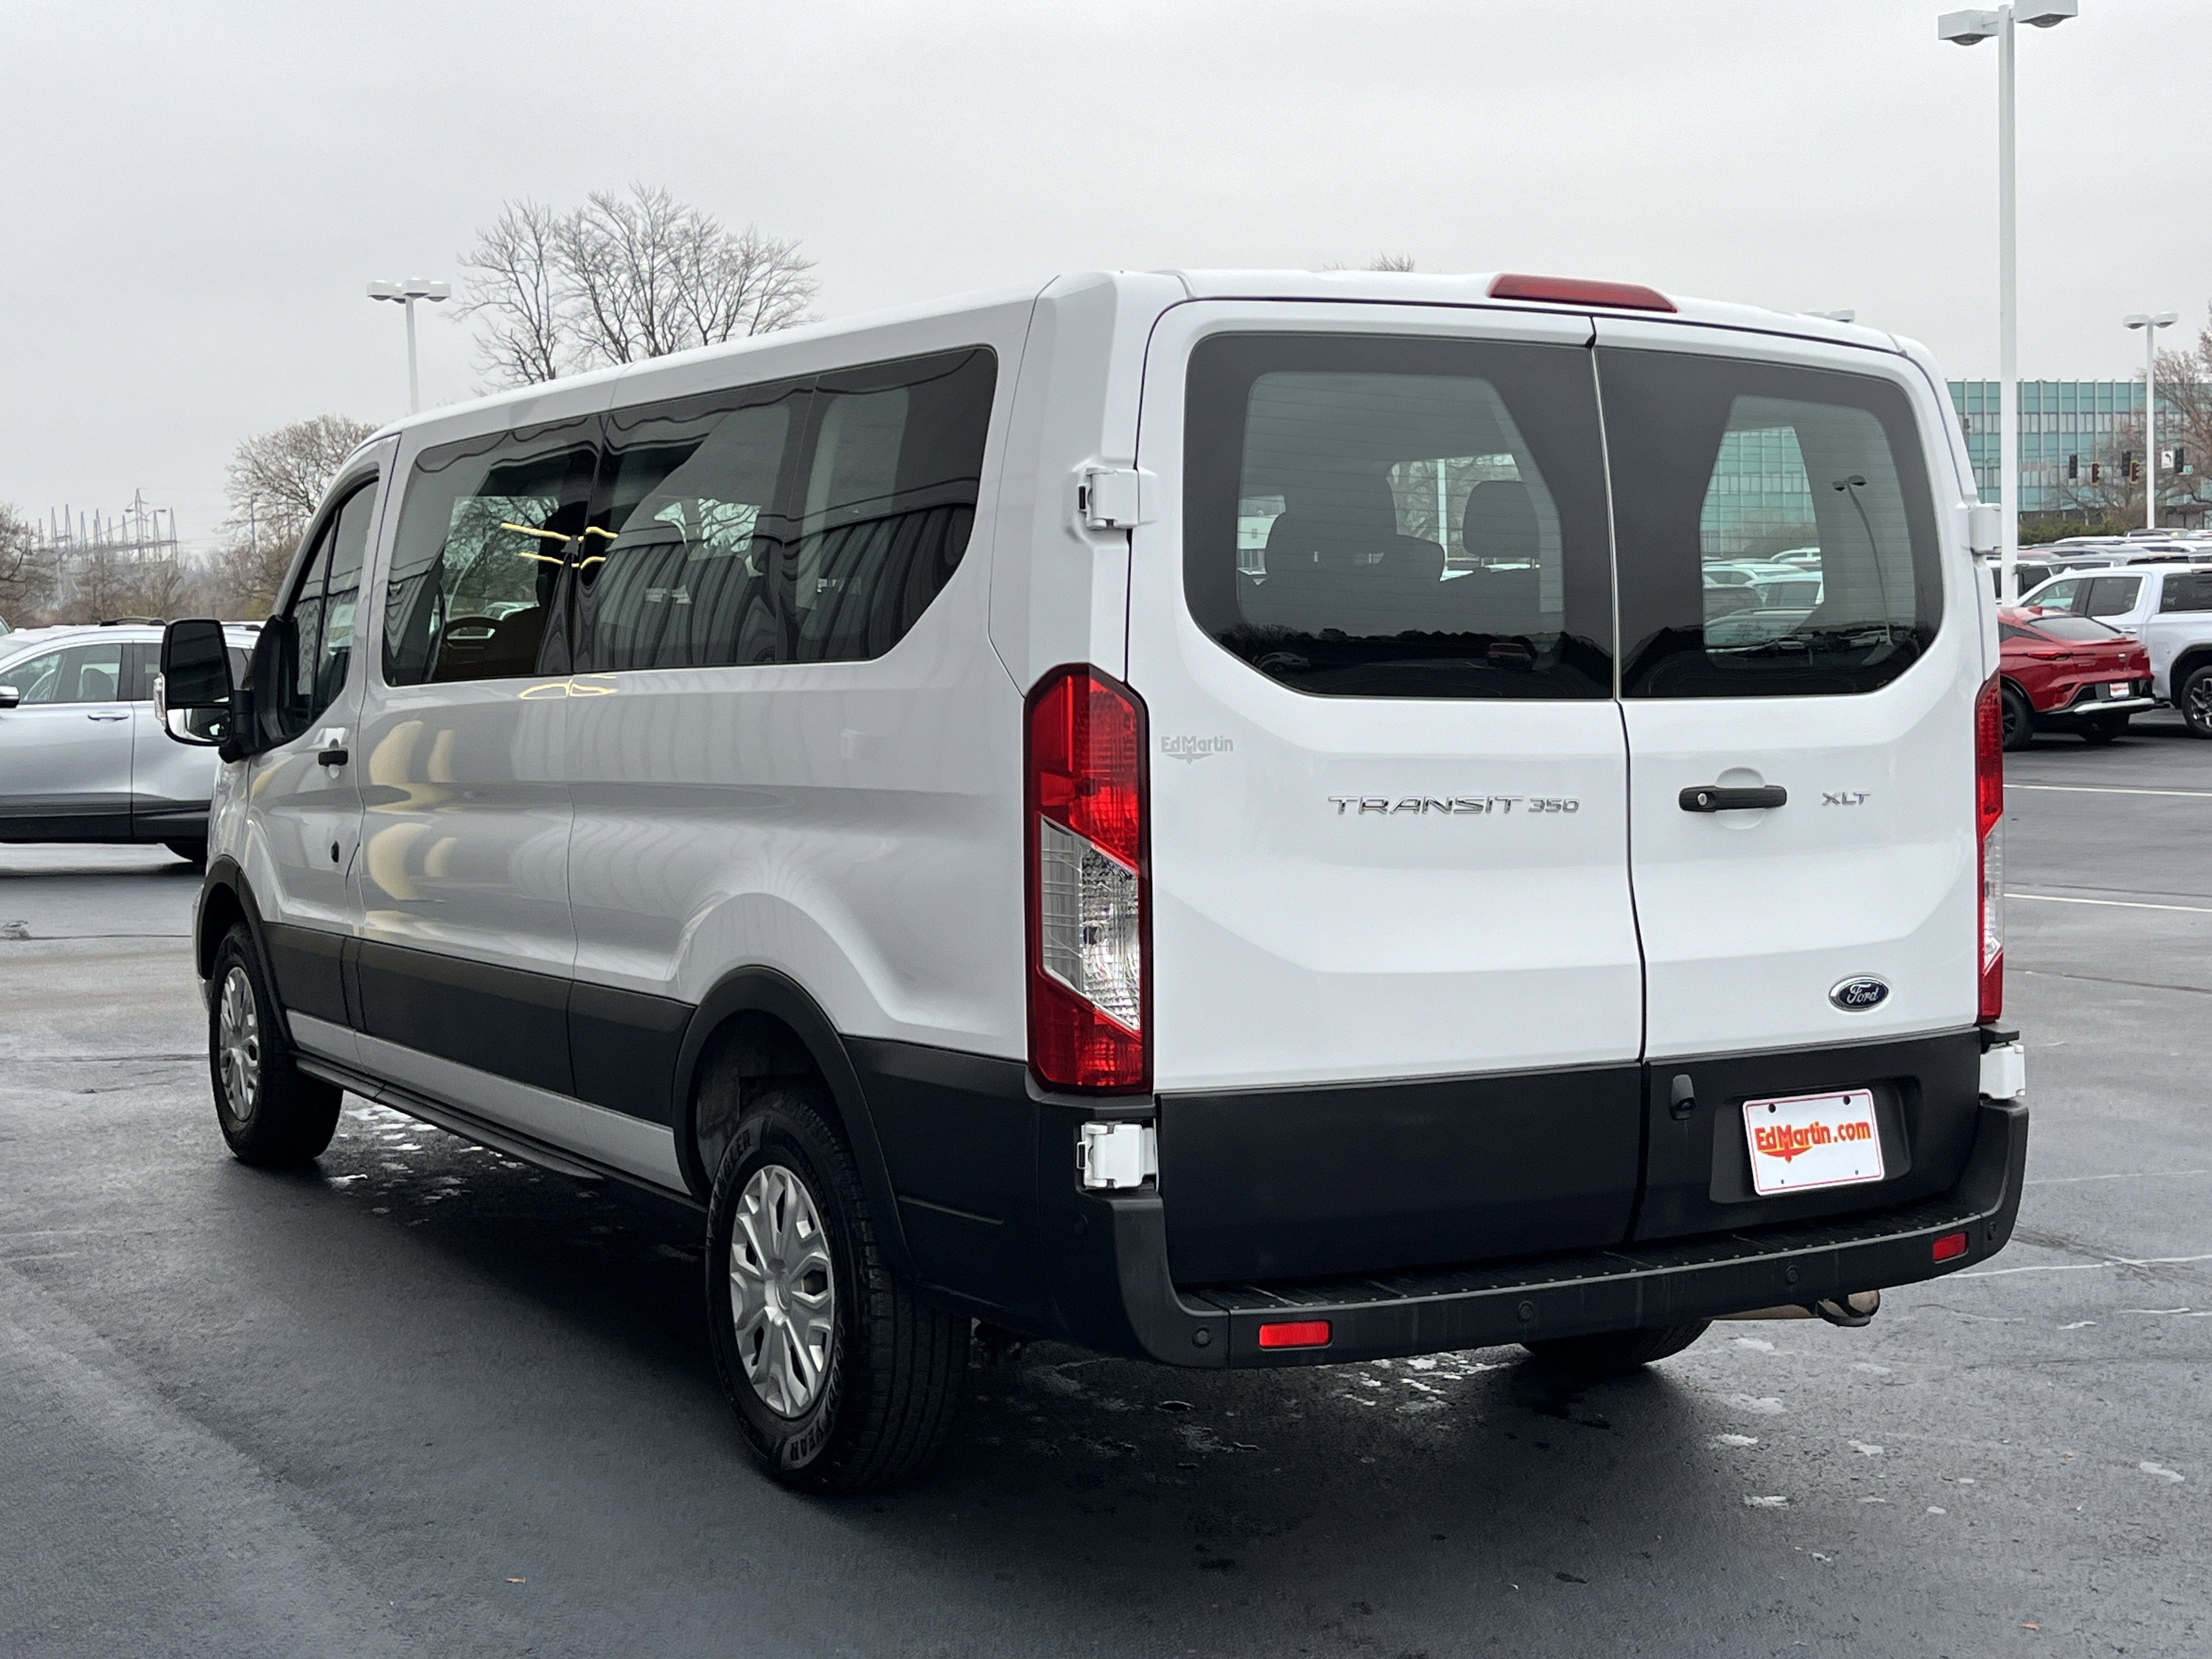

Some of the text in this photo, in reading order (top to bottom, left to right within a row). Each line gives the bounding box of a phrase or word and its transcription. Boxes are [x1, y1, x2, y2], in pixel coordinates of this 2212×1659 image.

[1161, 735, 1234, 753] EdMartin
[1328, 795, 1580, 815] TRANSIT 350
[1821, 792, 1871, 806] XLT
[1846, 983, 1880, 1004] Ford
[1755, 1121, 1871, 1152] EdMartin.com
